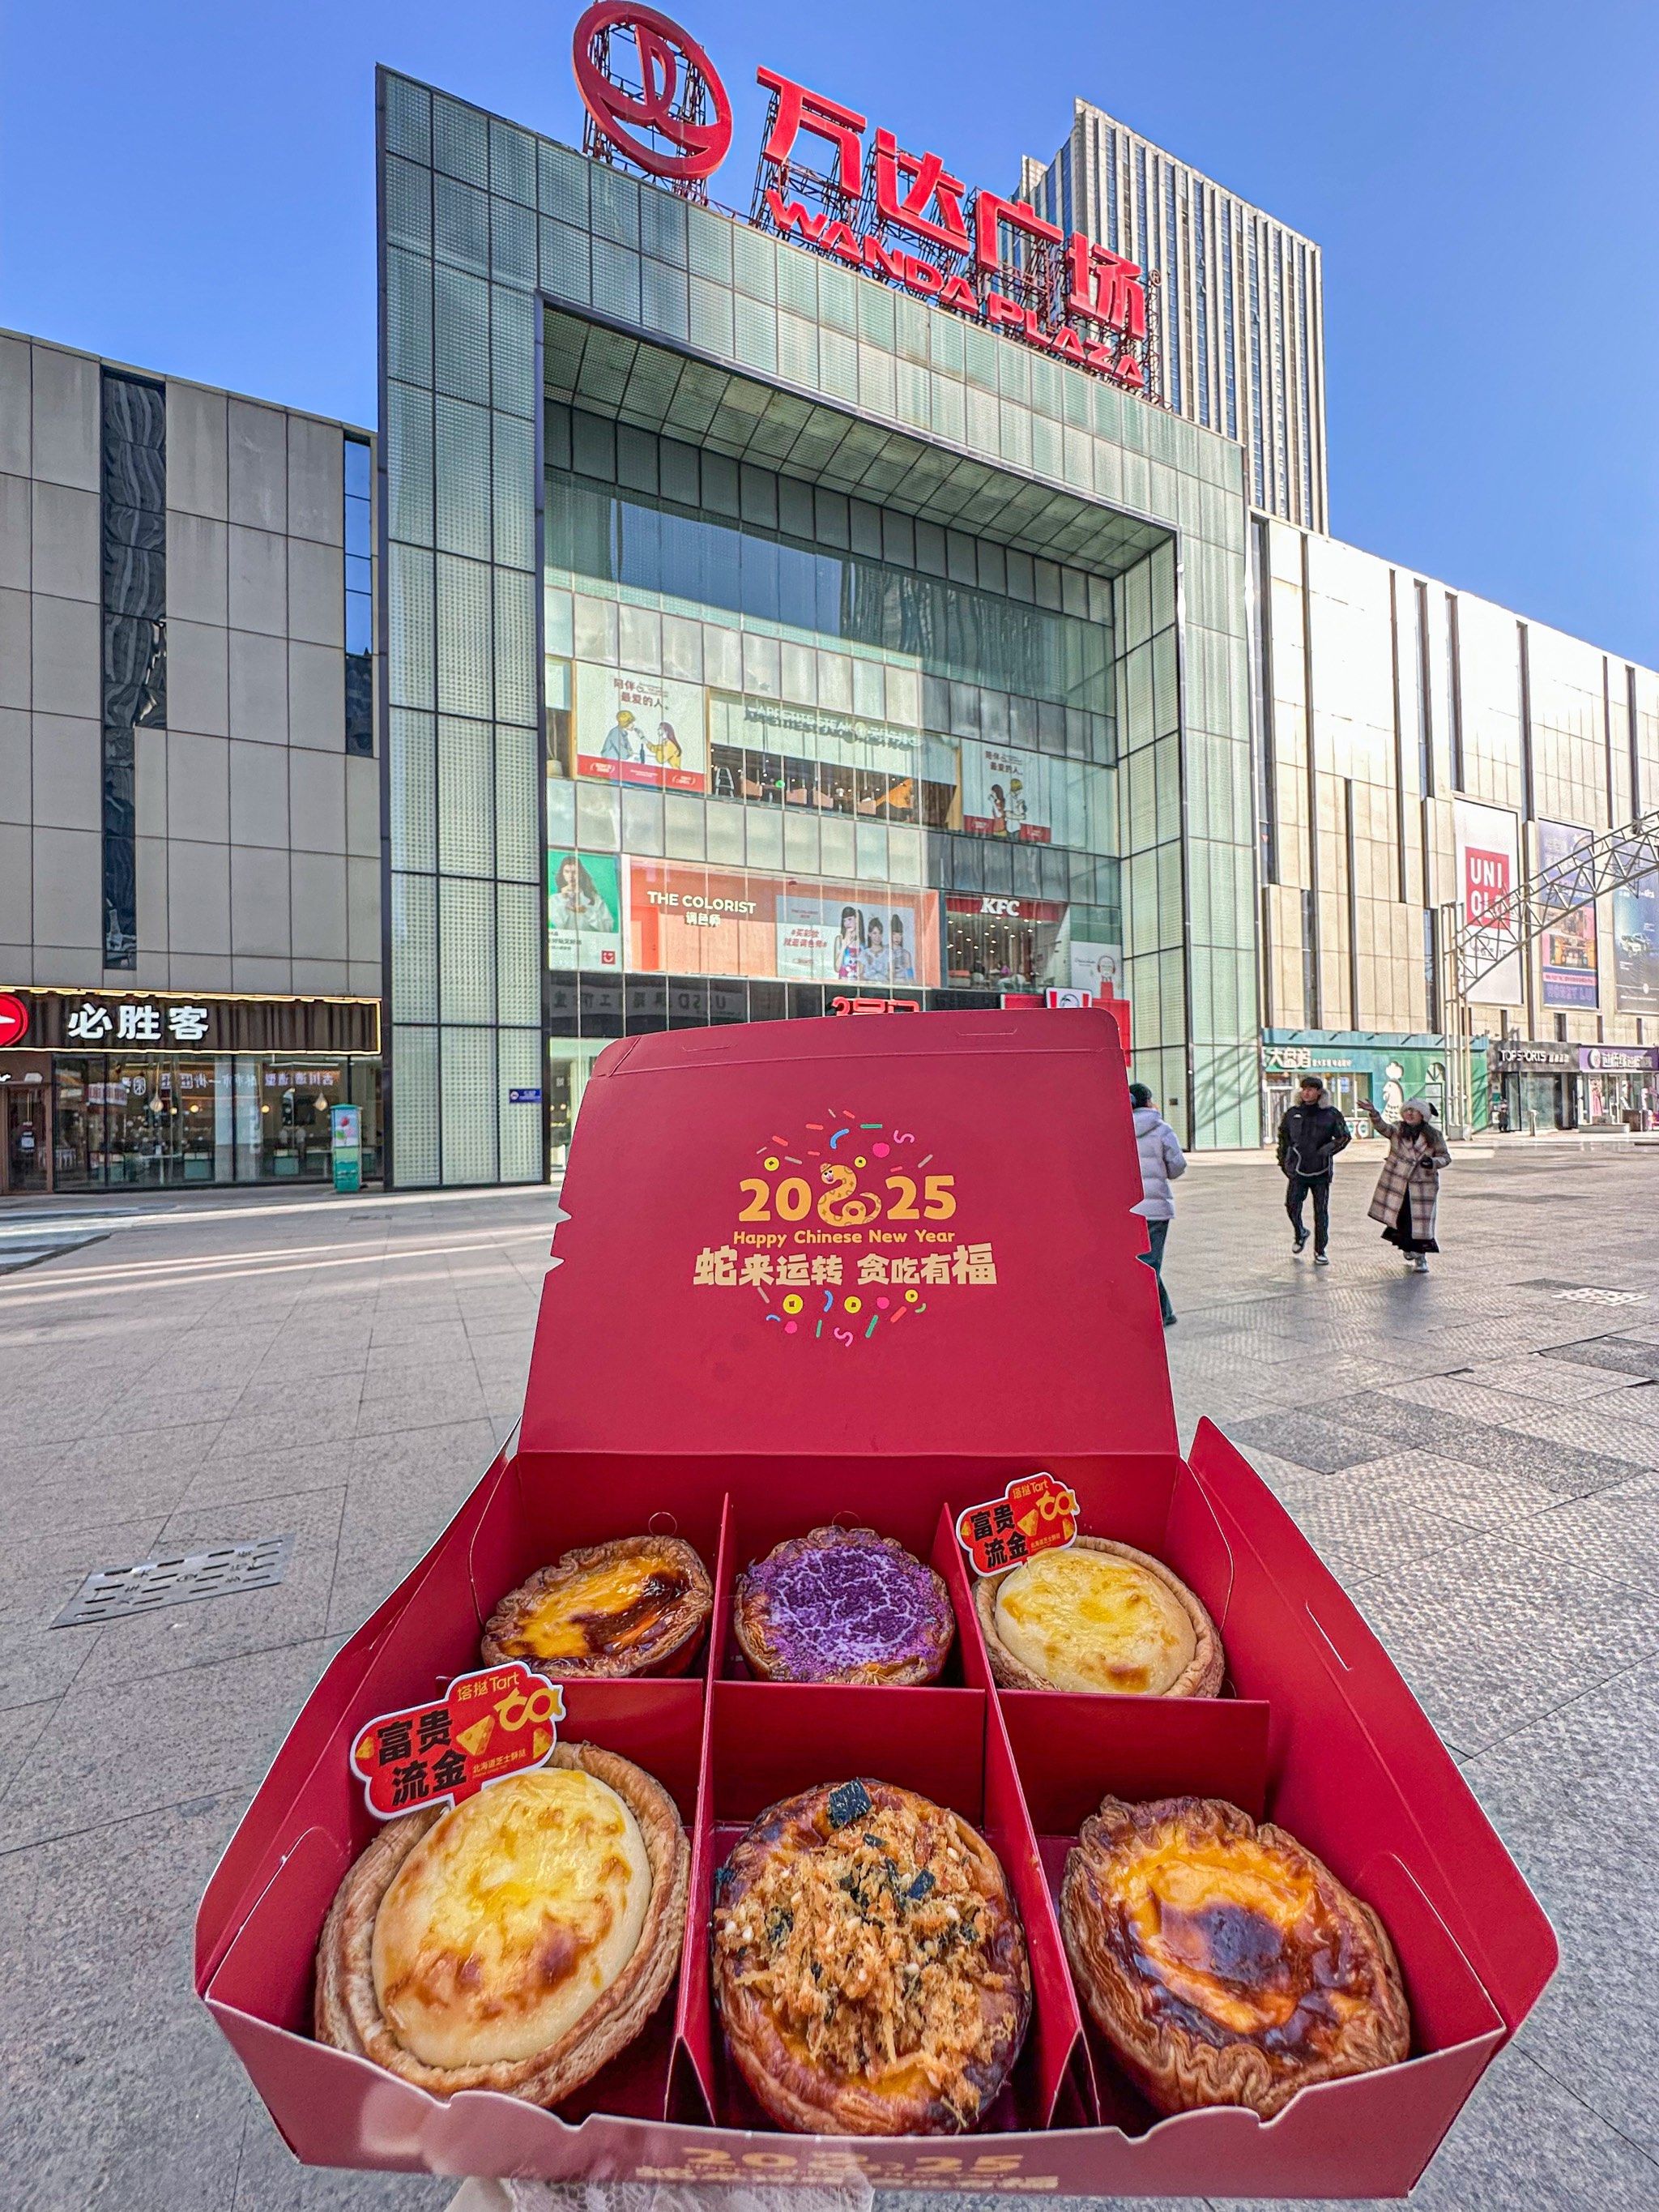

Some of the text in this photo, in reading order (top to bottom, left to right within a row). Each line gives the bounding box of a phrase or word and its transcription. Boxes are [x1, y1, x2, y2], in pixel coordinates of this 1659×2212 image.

[757, 66, 1145, 341] 万达广场
[765, 189, 1145, 388] WANDA PLAZA
[1469, 856, 1503, 889] UNI
[647, 890, 757, 914] THE COLORIST
[980, 897, 1020, 917] KFC
[68, 1002, 209, 1040] 必胜客
[733, 1229, 955, 1248] Happy Chinese New Year
[693, 1242, 997, 1286] 蛇来运转 贪吃有福
[1031, 1480, 1049, 1493] Tart
[970, 1504, 1015, 1541] 富贵
[984, 1531, 1029, 1569] 流金
[489, 1672, 520, 1693] Tart
[377, 1708, 453, 1766] 富贵
[391, 1749, 467, 1806] 流金
